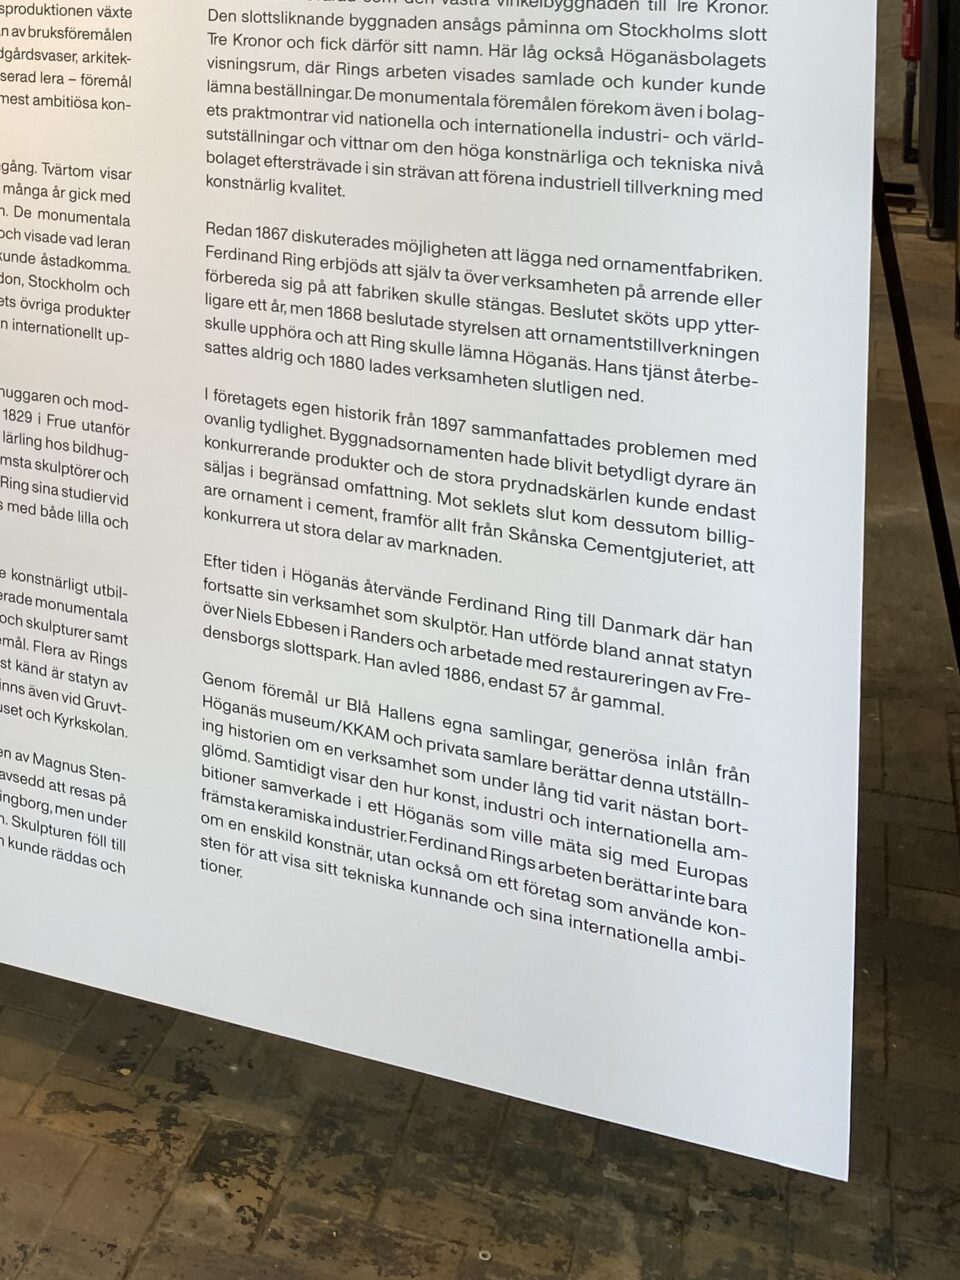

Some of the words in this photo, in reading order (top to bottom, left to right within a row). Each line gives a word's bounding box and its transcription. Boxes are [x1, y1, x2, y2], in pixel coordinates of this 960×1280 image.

[95, 4, 133, 19] växte
[206, 55, 300, 76] visningsrum,
[304, 59, 331, 75] där
[335, 60, 380, 80] Rings
[385, 63, 447, 81] arbeten
[452, 66, 516, 84] visades
[521, 70, 595, 88] samlade
[601, 73, 634, 89] och
[641, 74, 705, 93] kunder
[709, 77, 766, 96] kunde
[40, 161, 94, 179] Tvärtom
[98, 165, 133, 181] visar
[205, 220, 253, 238] Redan
[255, 224, 289, 241] 1867
[290, 228, 390, 251] diskuterades
[392, 238, 487, 260] möjligheten
[490, 246, 513, 262] att
[515, 246, 563, 269] lägga
[565, 254, 599, 269] ned
[602, 258, 763, 283] ornamentfabriken.
[1, 407, 33, 424] 1829
[37, 411, 42, 425] i
[46, 412, 77, 430] Frue
[81, 419, 131, 437] utanför
[204, 386, 208, 401] I
[212, 387, 287, 411] företagets
[291, 400, 330, 417] egen
[334, 402, 391, 424] historik
[394, 410, 426, 429] från
[430, 415, 467, 433] 1897
[470, 423, 611, 451] sammanfattades
[616, 440, 711, 463] problemen
[716, 452, 757, 469] med
[33, 457, 102, 480] skulptörer
[102, 468, 129, 484] och
[34, 597, 129, 624] monumentala
[202, 623, 280, 652] densborgs
[283, 638, 361, 665] slottspark.
[363, 650, 395, 670] Han
[398, 660, 441, 678] avled
[443, 665, 485, 688] 1886,
[487, 675, 544, 696] endast
[547, 682, 568, 699] 57
[570, 685, 589, 703] år
[590, 693, 665, 717] gammal.
[24, 708, 51, 723] och
[53, 711, 129, 739] Kyrkskolan.
[201, 693, 267, 719] Höganäs
[269, 709, 390, 743] museum/KKAM
[392, 732, 423, 749] och
[425, 738, 480, 760] privata
[482, 749, 548, 772] samlare
[550, 758, 618, 785] berättar
[619, 772, 675, 796] denna
[678, 785, 749, 809] utställn-
[47, 779, 67, 794] att
[69, 785, 106, 802] resas
[108, 792, 127, 807] på
[199, 835, 231, 853] sten
[234, 840, 256, 858] för
[258, 848, 278, 863] att
[280, 852, 311, 870] visa
[314, 859, 338, 877] sitt
[341, 865, 406, 892] tekniska
[409, 878, 489, 910] kunnande
[493, 900, 525, 918] och
[529, 906, 564, 927] sina
[568, 913, 689, 954] internationella
[694, 944, 746, 965] ambi-
